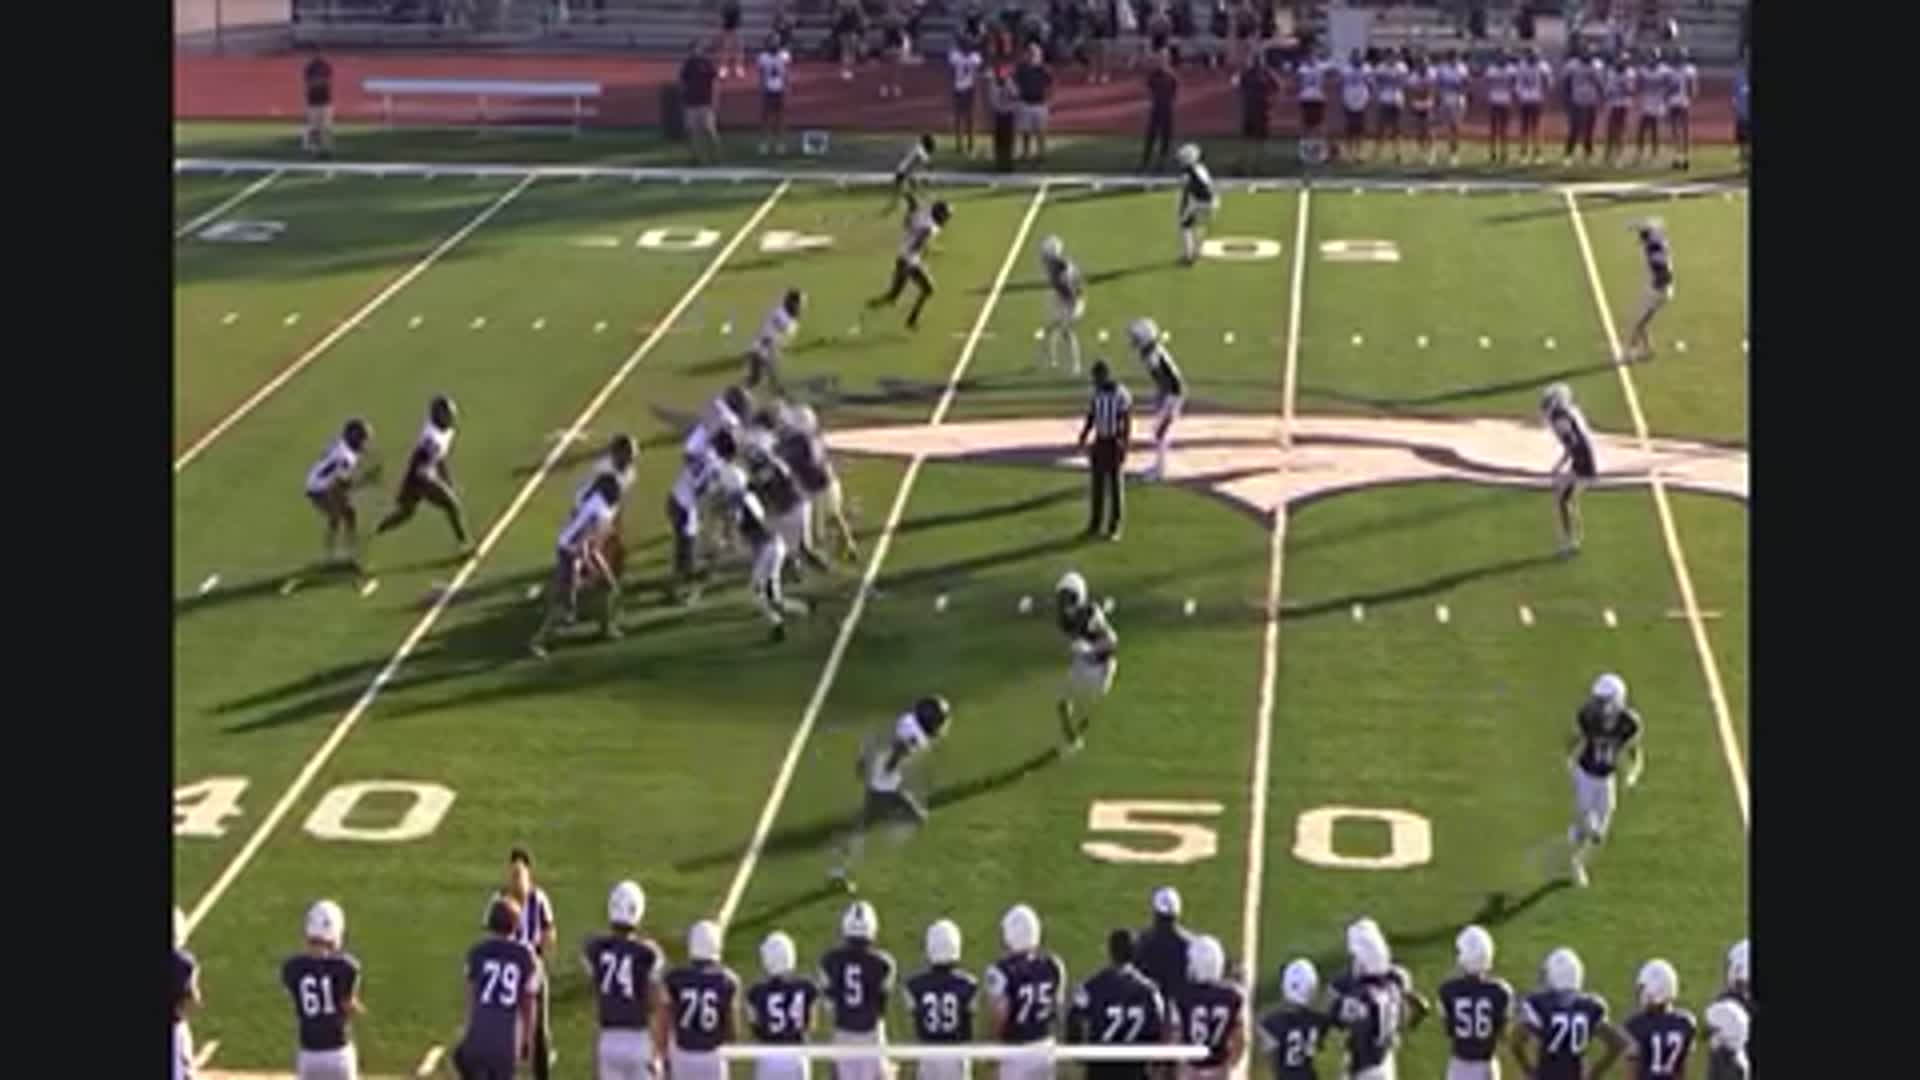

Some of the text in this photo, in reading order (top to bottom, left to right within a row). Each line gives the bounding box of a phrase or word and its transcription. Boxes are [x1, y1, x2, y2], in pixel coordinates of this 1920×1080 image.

[1081, 799, 1432, 869] 50
[299, 976, 335, 1016] 61
[482, 961, 520, 1005] 79
[600, 954, 634, 998] 74
[845, 967, 864, 1007] 5
[681, 990, 719, 1030] 76
[766, 992, 806, 1032] 54
[921, 993, 959, 1031] 39
[1017, 981, 1054, 1023] 75
[1454, 998, 1493, 1040] 56
[1102, 1006, 1145, 1041] 77
[1189, 1006, 1229, 1047] 67
[1549, 1013, 1590, 1055] 70
[1651, 1030, 1684, 1073] 17
